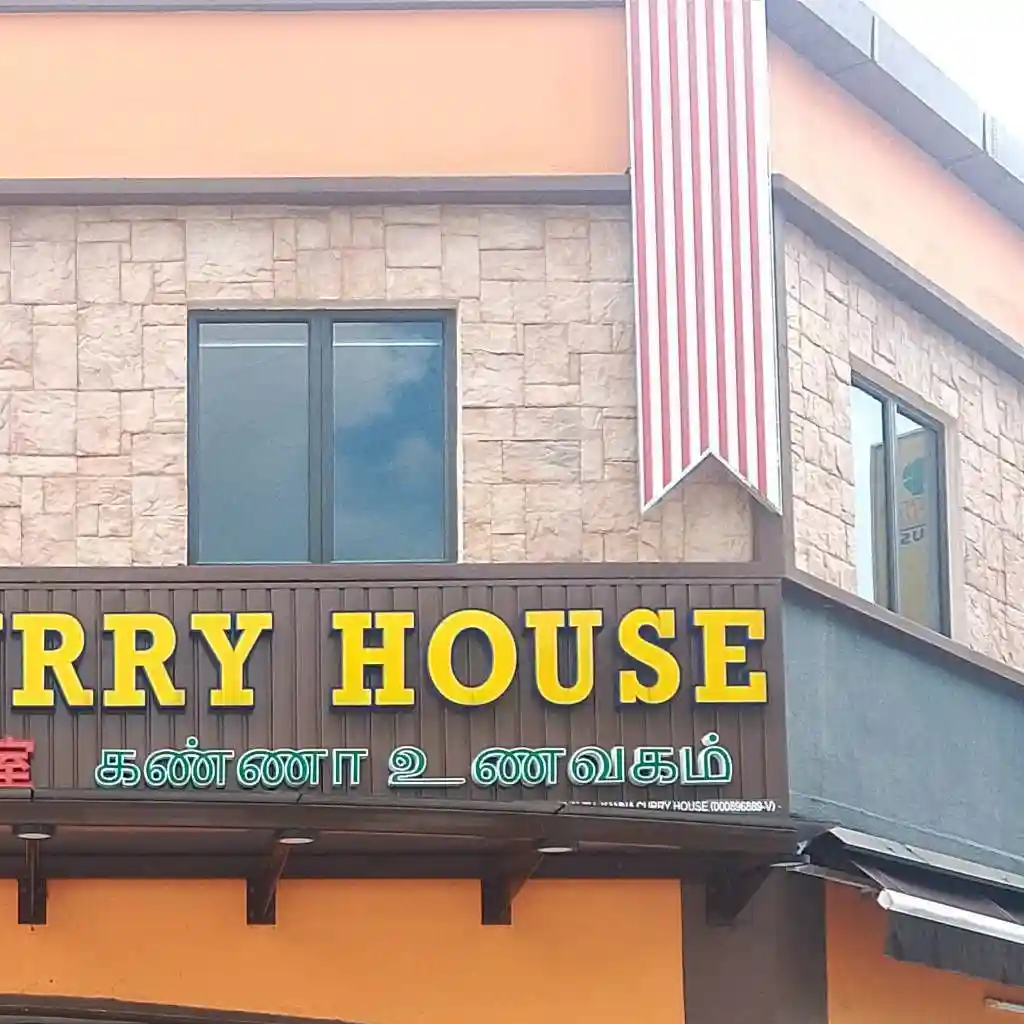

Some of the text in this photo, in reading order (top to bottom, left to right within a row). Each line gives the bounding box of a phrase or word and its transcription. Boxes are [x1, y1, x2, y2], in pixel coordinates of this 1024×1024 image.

[332, 609, 768, 706] HOUSE
[95, 736, 369, 788] கண்ணா
[673, 801, 709, 812] HOUSE
